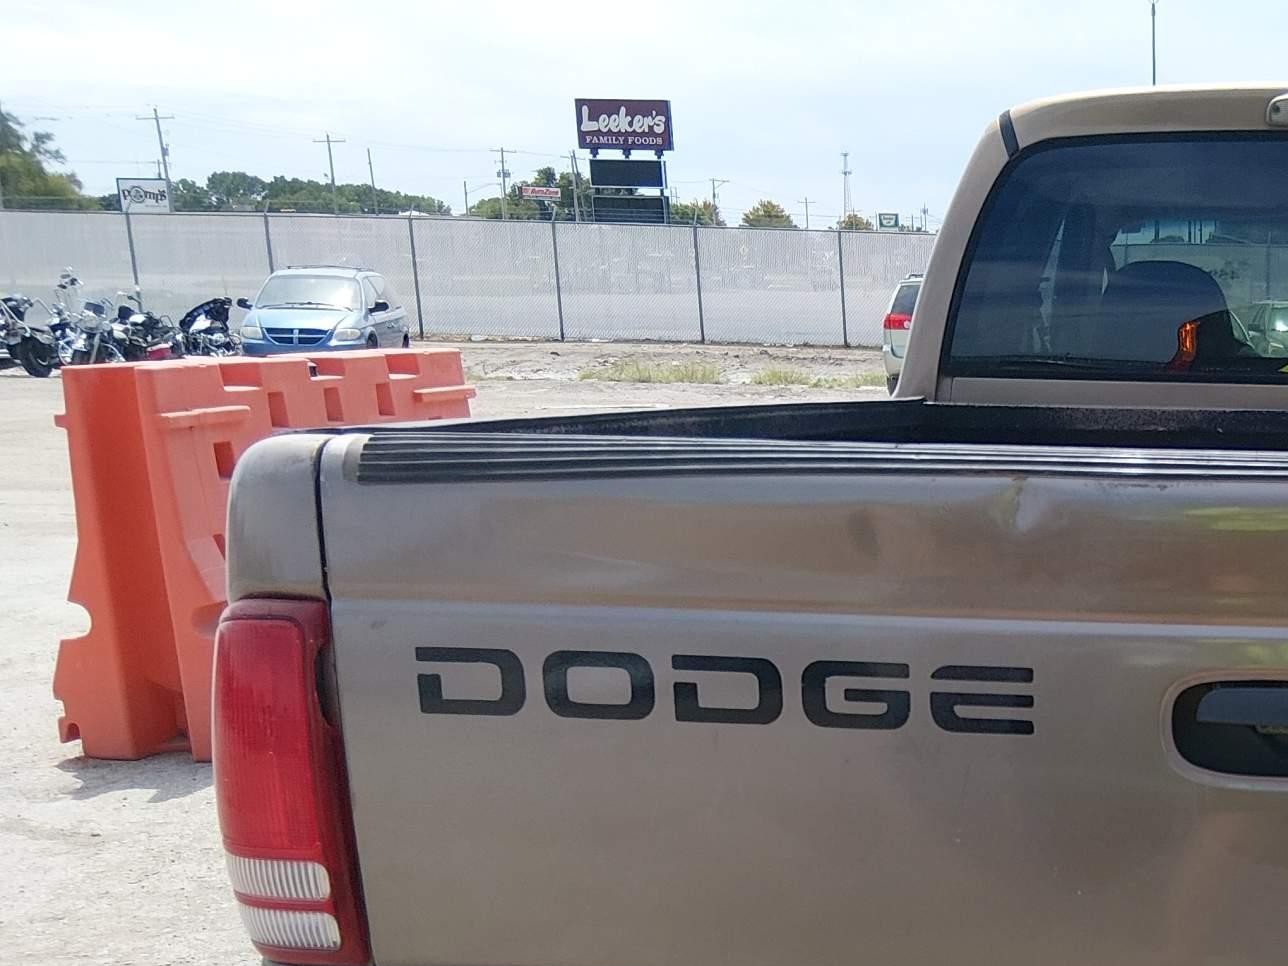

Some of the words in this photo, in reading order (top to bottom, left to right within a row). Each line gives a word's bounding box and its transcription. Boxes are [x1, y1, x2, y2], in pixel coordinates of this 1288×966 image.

[581, 105, 666, 134] Leeker's
[586, 136, 624, 144] FAMILY
[628, 137, 663, 145] FOODS
[415, 647, 1035, 735] DODGE
